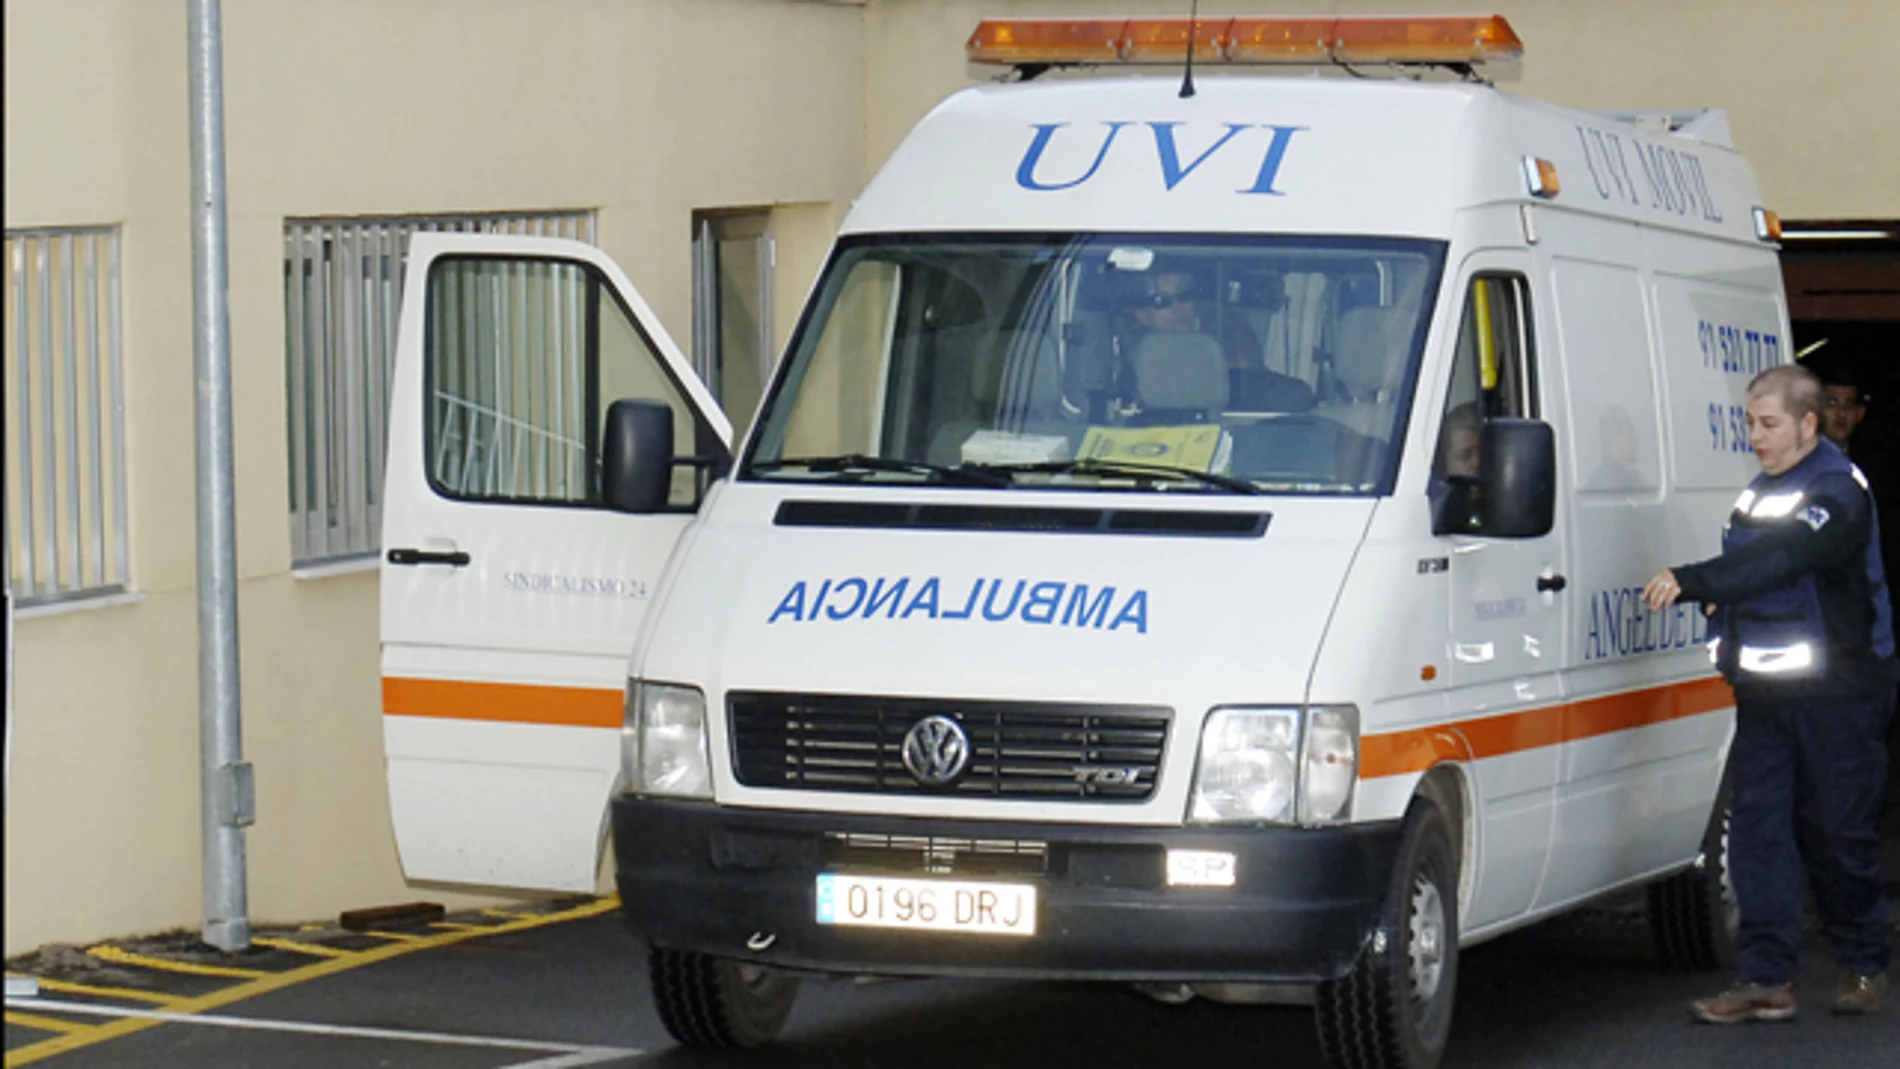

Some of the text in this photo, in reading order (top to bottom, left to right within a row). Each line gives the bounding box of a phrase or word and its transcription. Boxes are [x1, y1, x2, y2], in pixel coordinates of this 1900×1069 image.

[1015, 120, 1311, 196] UVI
[1576, 125, 1639, 205] UVI
[1729, 405, 1754, 453] 53
[848, 884, 1023, 927] 0196 DRJ
